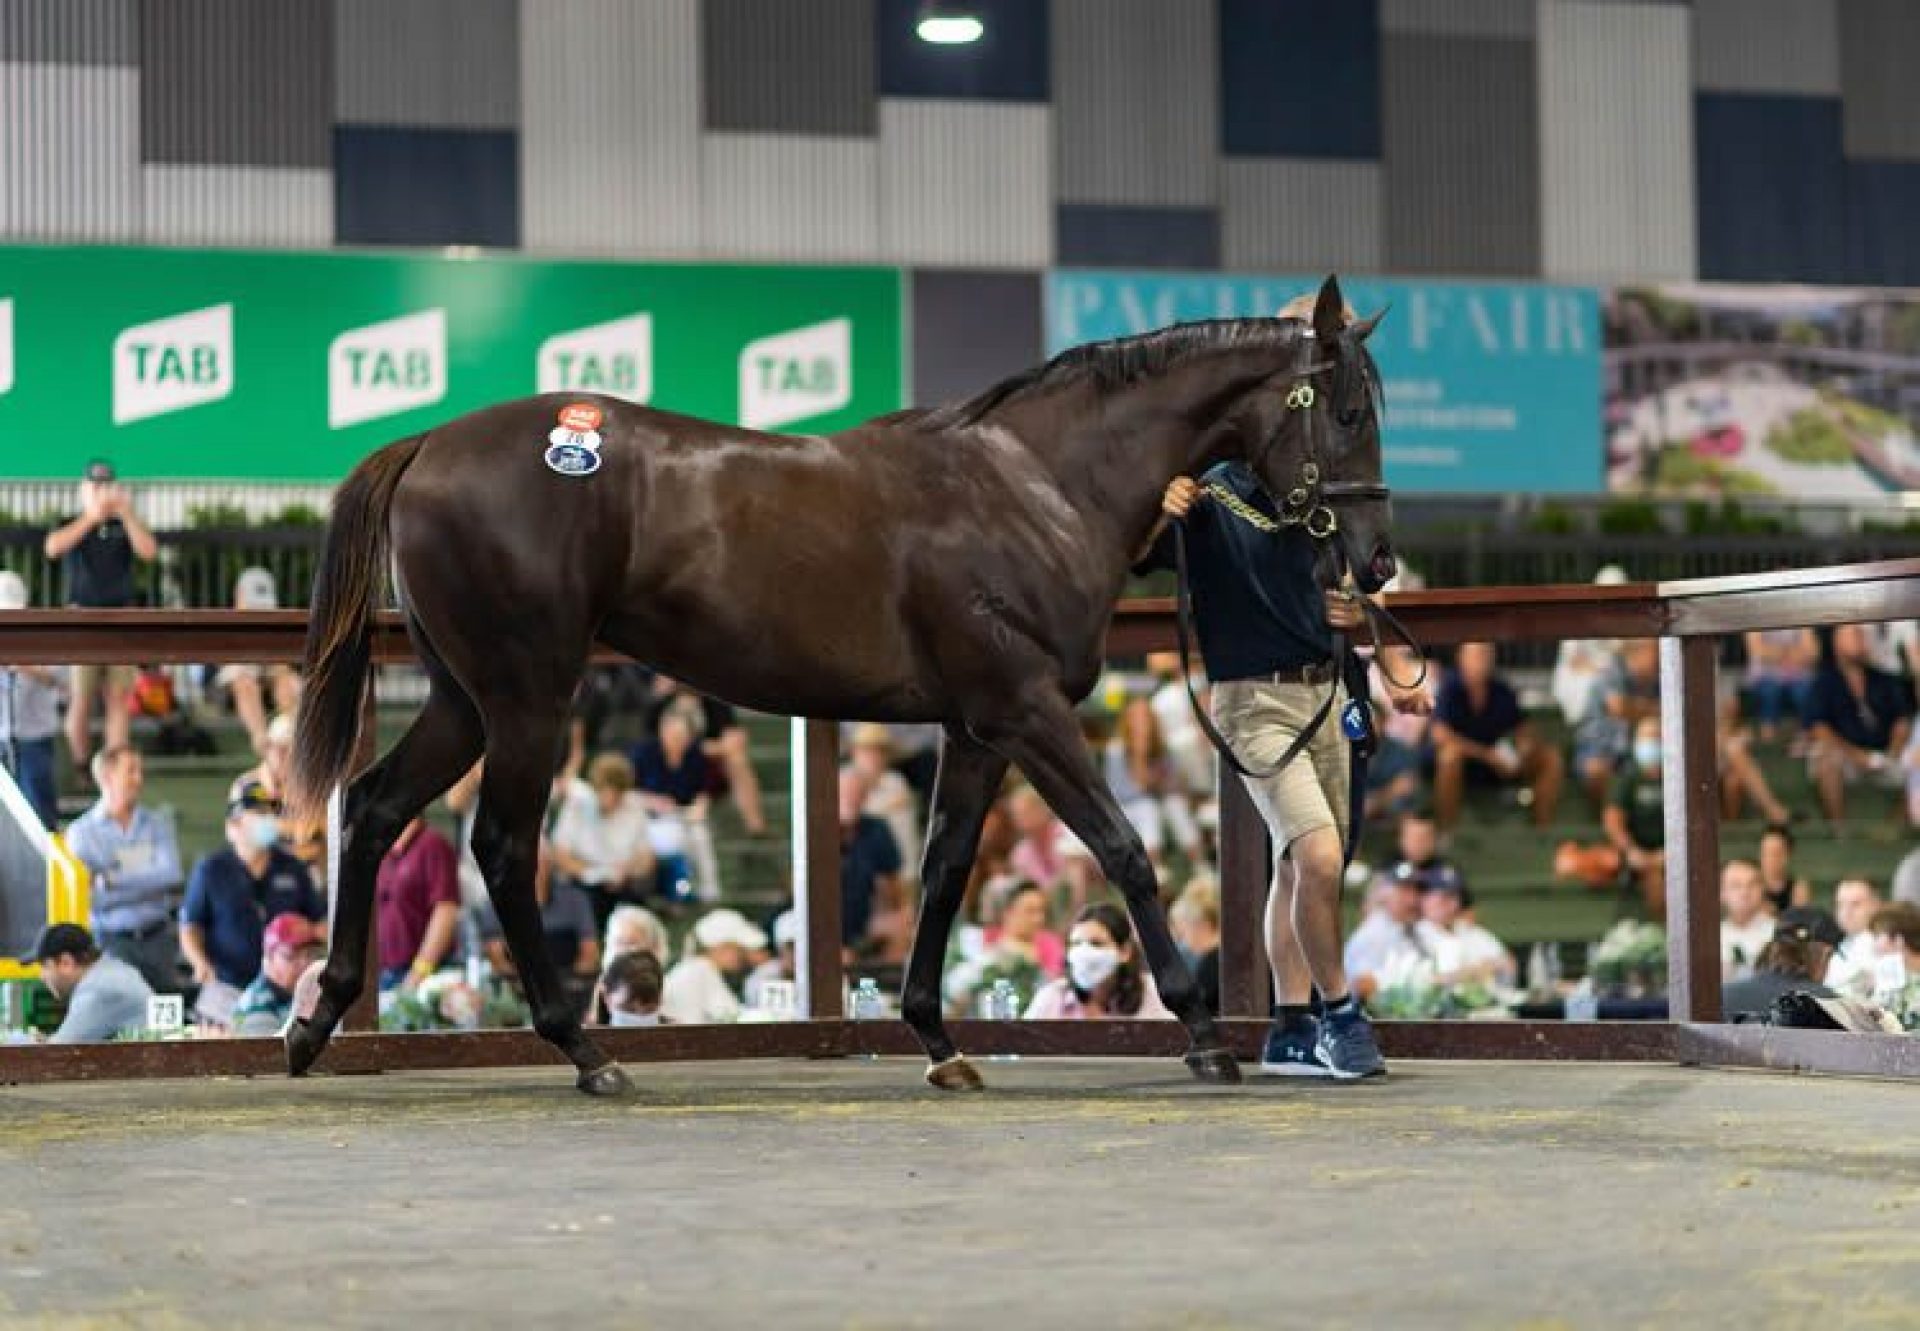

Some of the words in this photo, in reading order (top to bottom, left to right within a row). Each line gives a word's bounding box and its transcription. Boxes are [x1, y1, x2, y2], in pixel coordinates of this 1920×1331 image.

[1409, 288, 1589, 350] FAIR
[127, 342, 220, 384] TAB
[342, 346, 431, 389] TAB
[554, 351, 637, 390] TAB
[755, 356, 836, 394] TAB
[153, 1001, 177, 1025] 73
